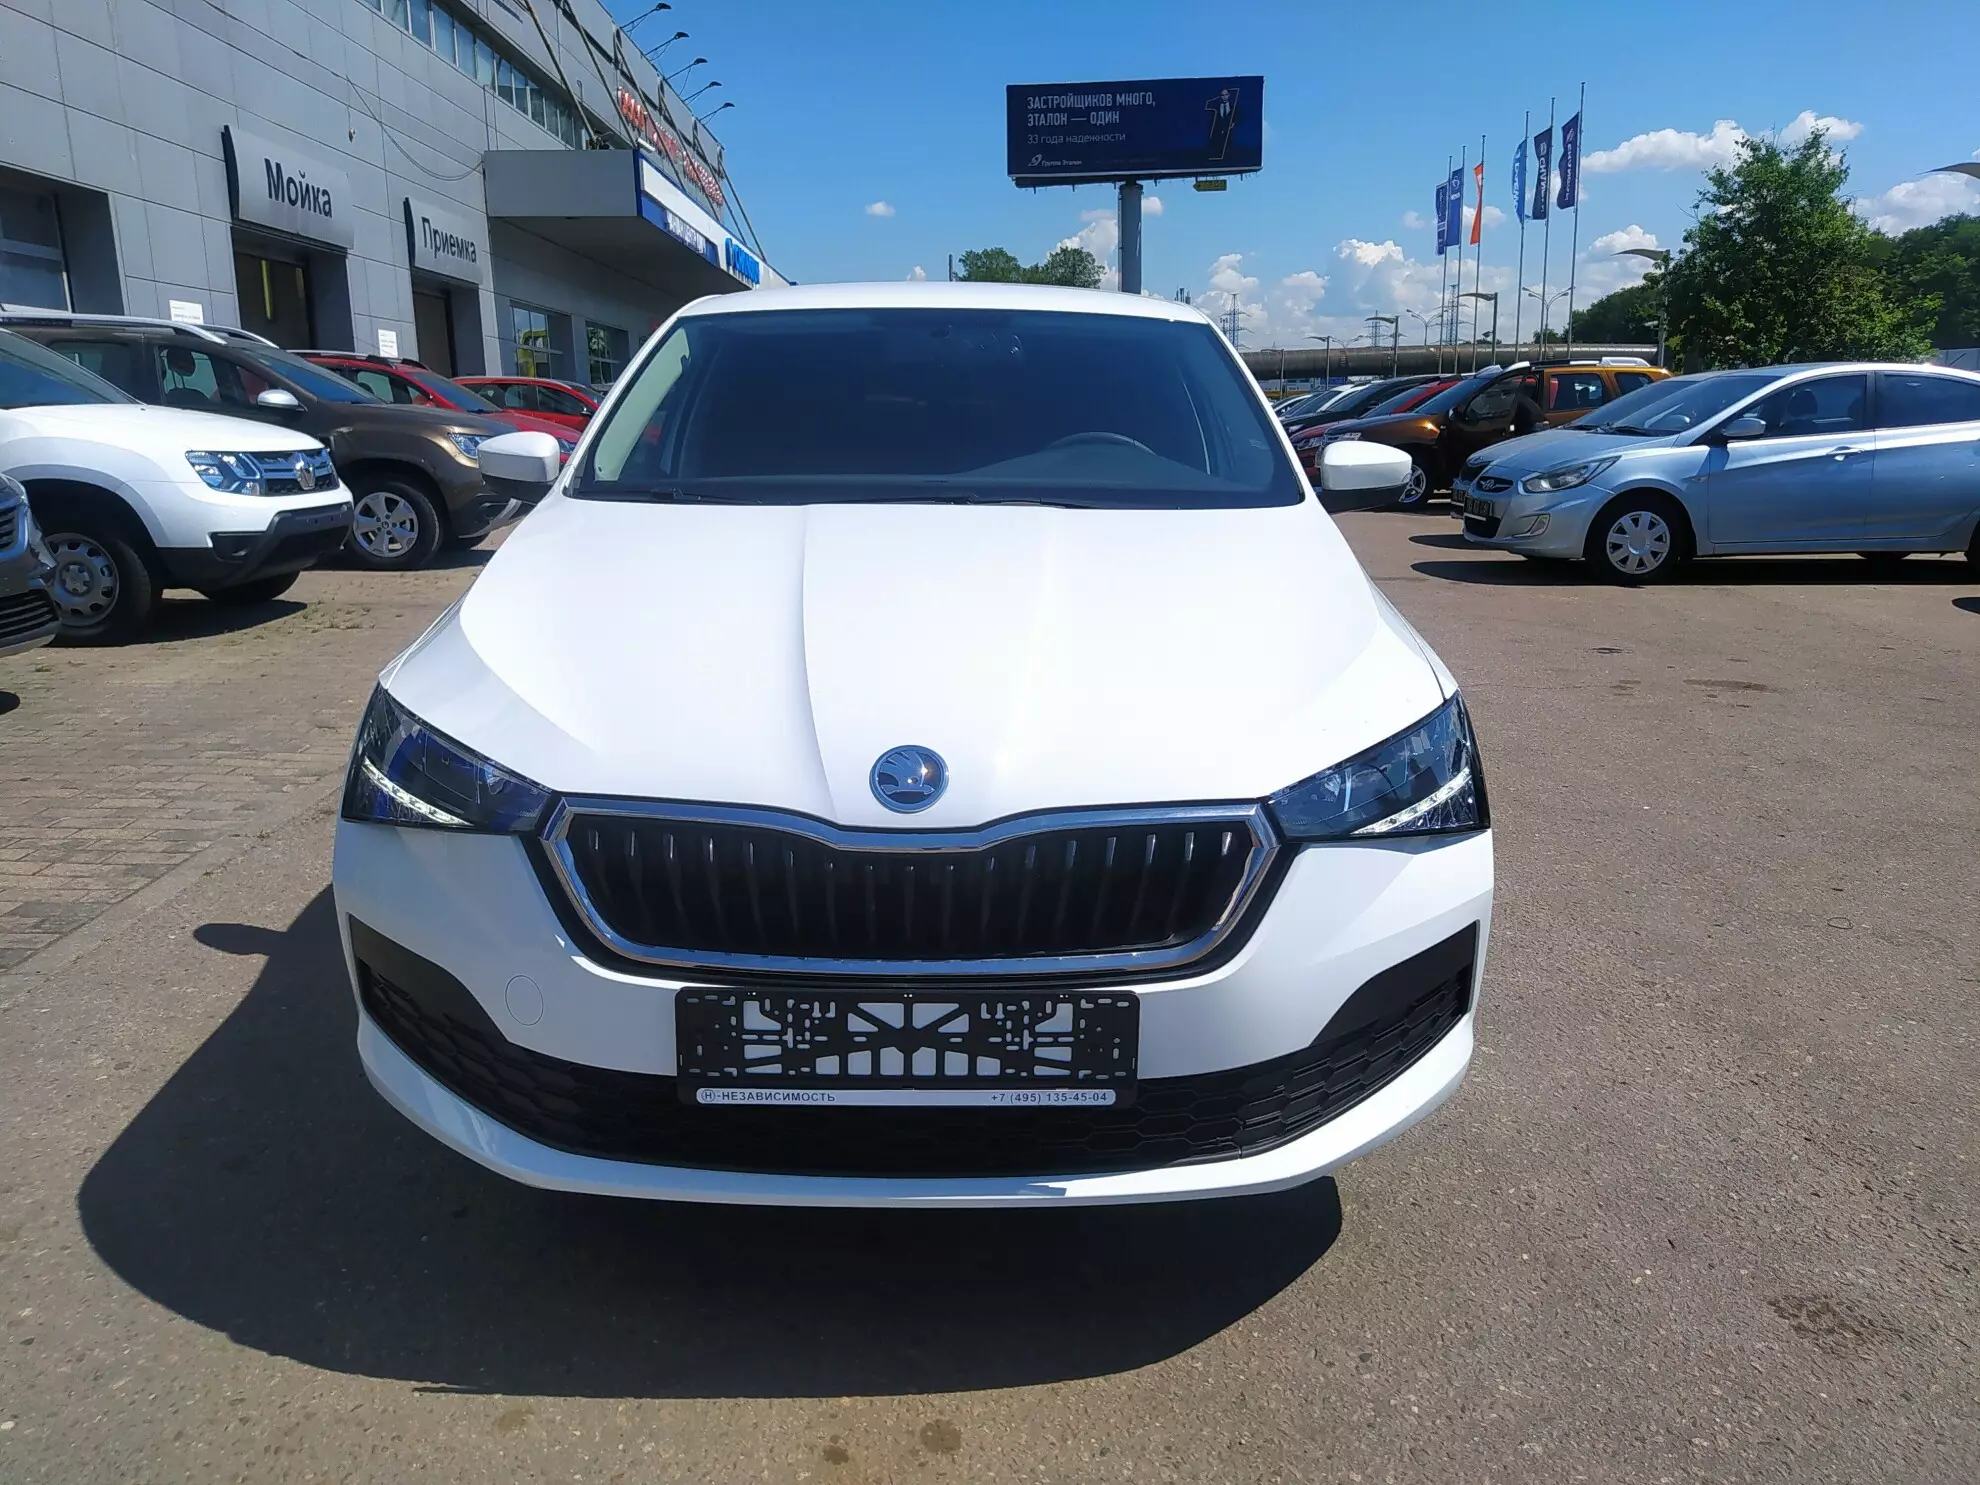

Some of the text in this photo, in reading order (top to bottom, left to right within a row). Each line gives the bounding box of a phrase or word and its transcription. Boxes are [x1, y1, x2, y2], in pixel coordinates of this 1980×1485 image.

[1027, 92, 1156, 110] ЗАСТРОЙЩИКОВ МНОГО,
[1027, 112, 1068, 126] ЭТАЛОН
[1090, 110, 1120, 126] ОДИН
[1027, 133, 1126, 146] 33 года надежности
[264, 157, 332, 218] Мойка
[421, 216, 477, 265] Приемка
[991, 1092, 1107, 1104] +7 (495) 135-45-04
